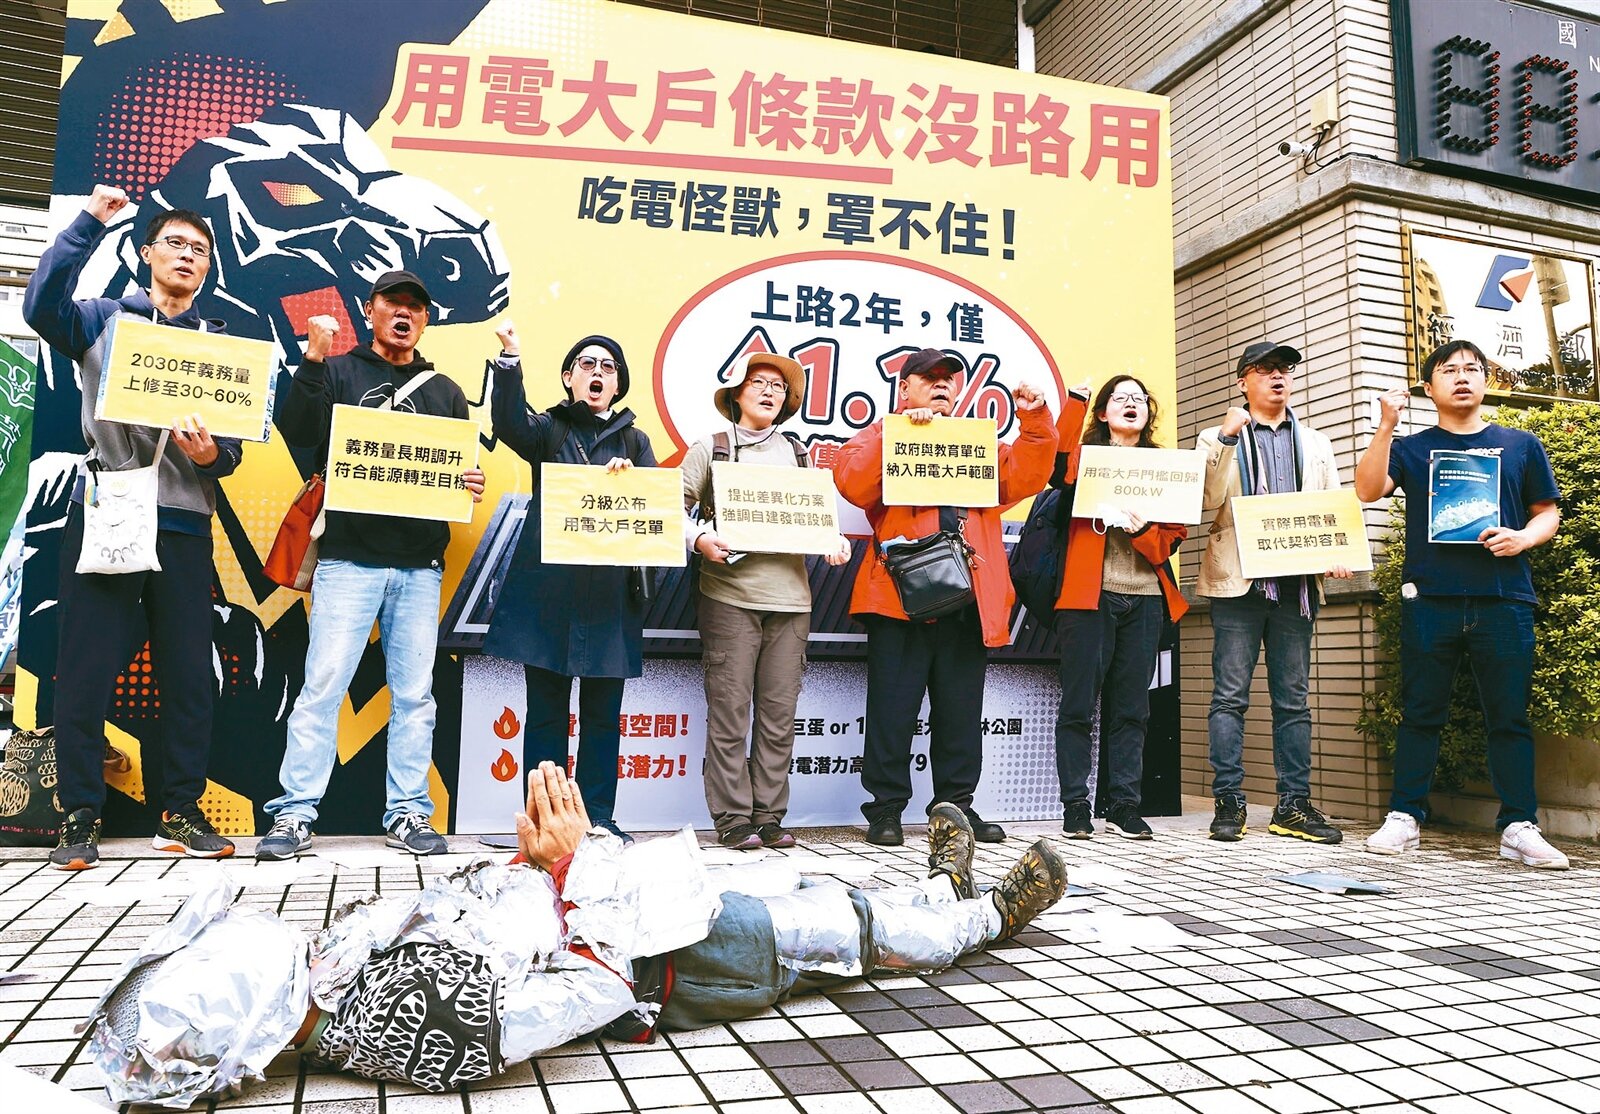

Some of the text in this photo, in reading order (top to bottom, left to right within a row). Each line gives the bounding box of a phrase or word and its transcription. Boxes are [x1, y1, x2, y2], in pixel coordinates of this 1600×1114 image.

[1557, 19, 1577, 49] 國
[391, 52, 1162, 188] 用電大戶條款沒路用
[130, 352, 251, 385] 2030年義務量
[123, 374, 252, 407] 上修至30~60%
[345, 438, 464, 467] 義務量長期調升
[894, 441, 987, 459] 政府與教育單位
[334, 460, 469, 491] 符合能源轉型目標
[886, 462, 995, 480] 納入用電大戶範圍
[1083, 466, 1199, 483] 用電大戶門檻回歸
[727, 487, 825, 508] 提出差異化方案
[1113, 484, 1164, 497] 800kW
[580, 494, 647, 512] 分級公布
[563, 516, 664, 536] 用電大戶名單
[722, 507, 834, 528] 強調自建發電設備
[1261, 513, 1338, 532] 實際用電量
[1257, 532, 1349, 551] 取代契約容量
[829, 722, 850, 735] or
